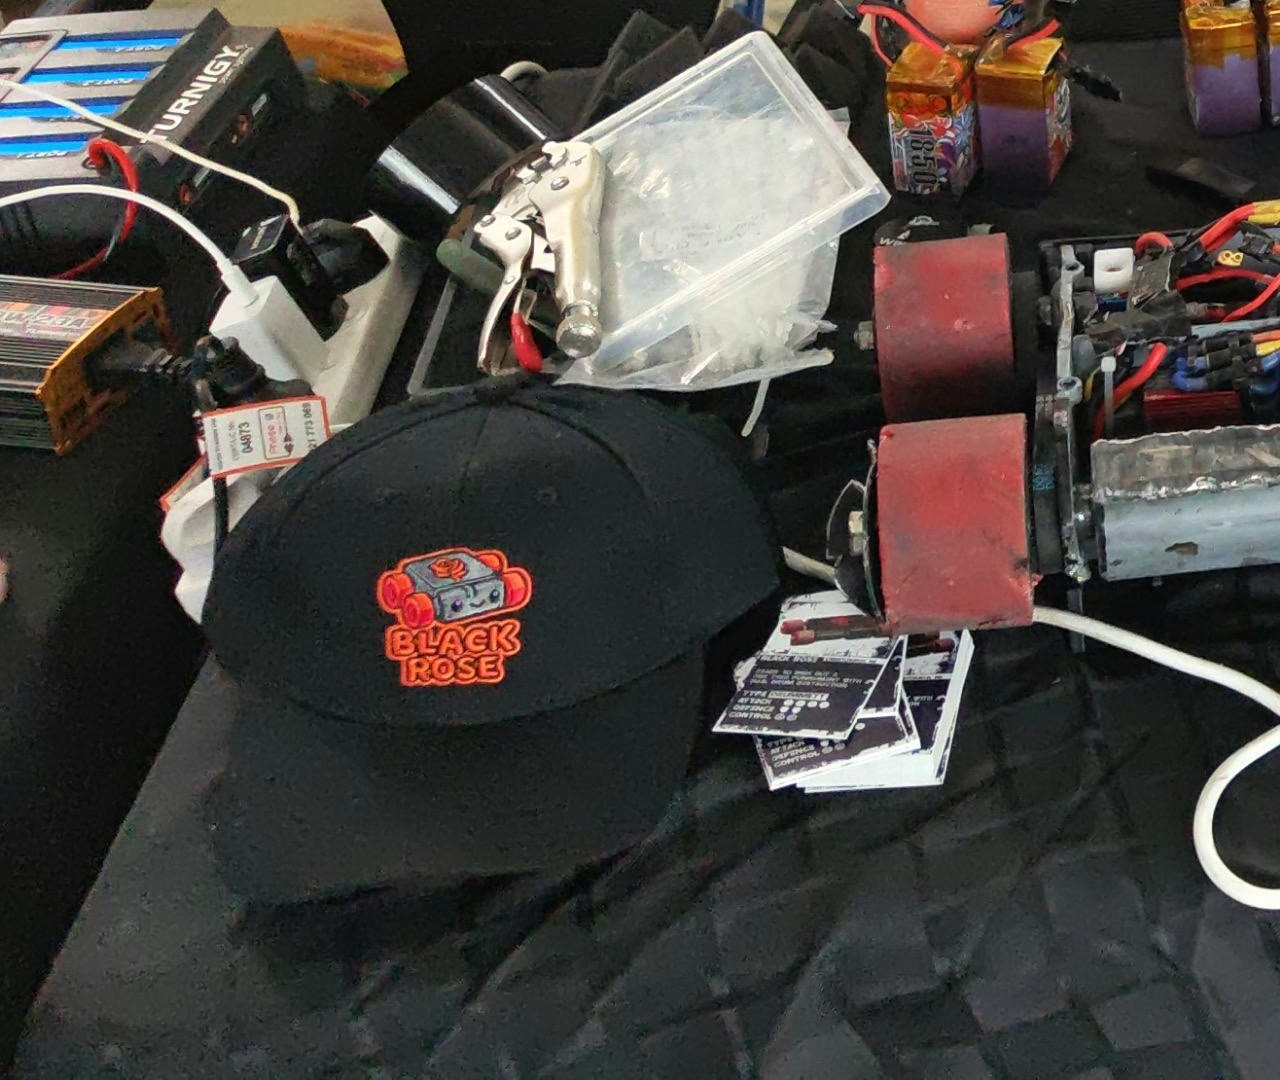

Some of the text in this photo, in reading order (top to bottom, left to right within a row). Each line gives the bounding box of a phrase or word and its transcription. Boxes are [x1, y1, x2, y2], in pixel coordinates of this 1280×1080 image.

[140, 45, 241, 144] TURNIGY
[908, 127, 938, 185] 1850
[390, 622, 517, 656] BLACK
[406, 655, 499, 682] ROSE
[728, 712, 772, 720] CONTROL
